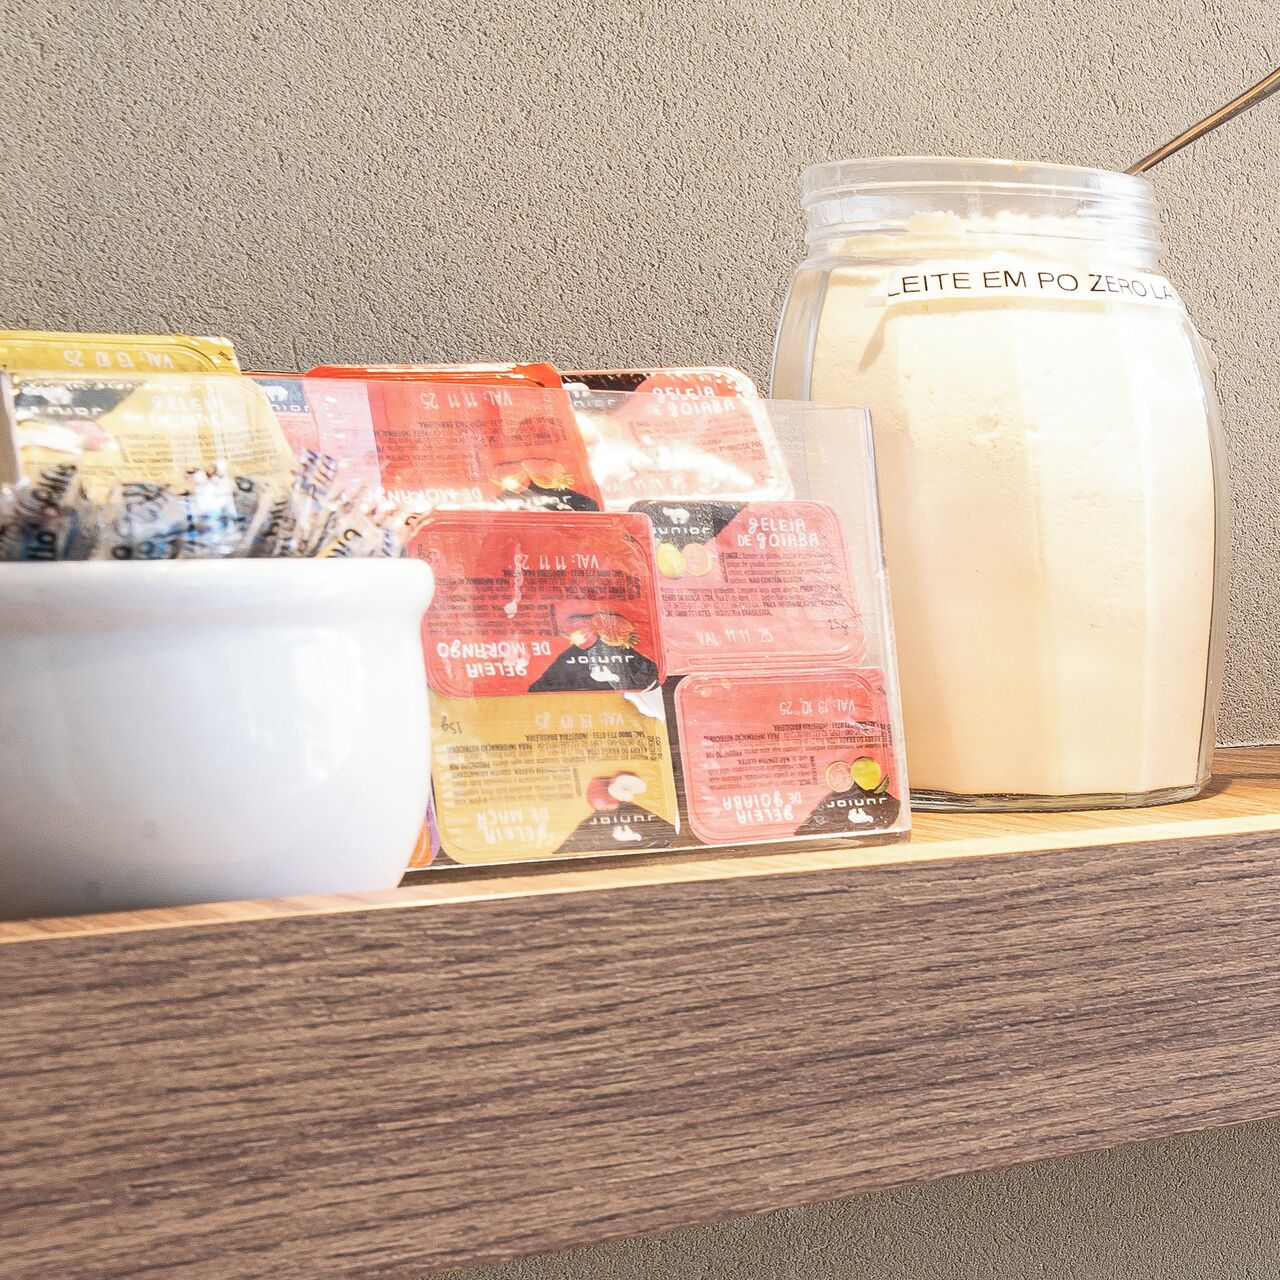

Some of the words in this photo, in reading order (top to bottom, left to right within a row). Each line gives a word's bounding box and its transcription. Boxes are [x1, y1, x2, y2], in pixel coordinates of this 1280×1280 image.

[983, 270, 1027, 289] EM
[1038, 273, 1079, 292] PO
[1089, 273, 1147, 298] ZERO
[420, 392, 439, 409] 25
[737, 535, 751, 548] DE
[531, 641, 552, 656] DE
